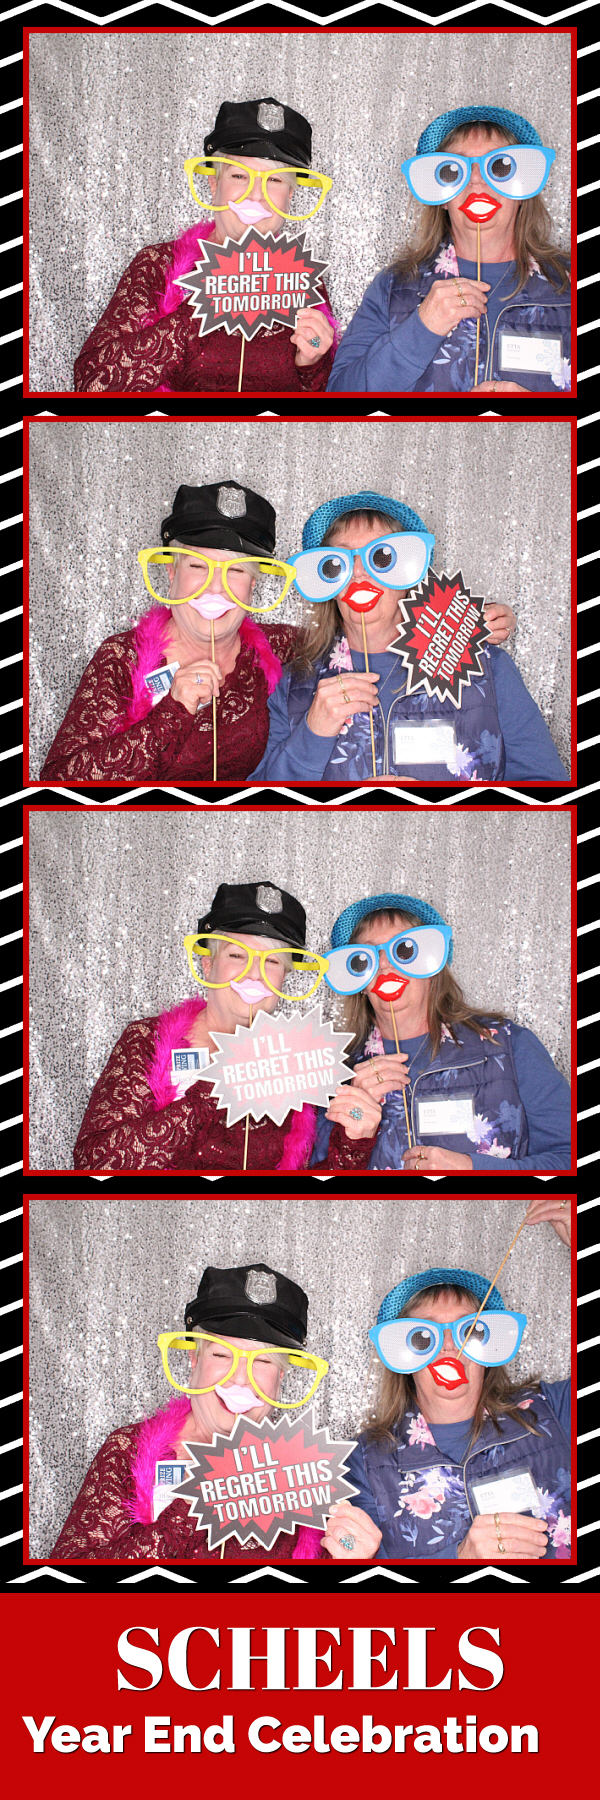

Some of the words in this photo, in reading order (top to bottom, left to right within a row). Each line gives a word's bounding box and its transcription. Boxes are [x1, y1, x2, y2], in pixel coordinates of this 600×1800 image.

[239, 251, 273, 273] I'LL
[205, 273, 270, 295] REGRET
[274, 272, 310, 292] THIS
[212, 292, 306, 314] TOMORROW
[415, 605, 442, 638] I'LL
[418, 618, 456, 677] REGRET
[445, 590, 470, 624] THIS
[437, 604, 481, 681] TOMORROW
[252, 1033, 291, 1058] I'LL
[222, 1054, 289, 1085] REGRET
[294, 1047, 336, 1071] THIS
[233, 1068, 334, 1102] TOMORROW
[233, 1442, 279, 1472] I'LL
[200, 1468, 277, 1503] REGRET
[282, 1459, 333, 1488] THIS
[214, 1484, 332, 1523] TOMORROW
